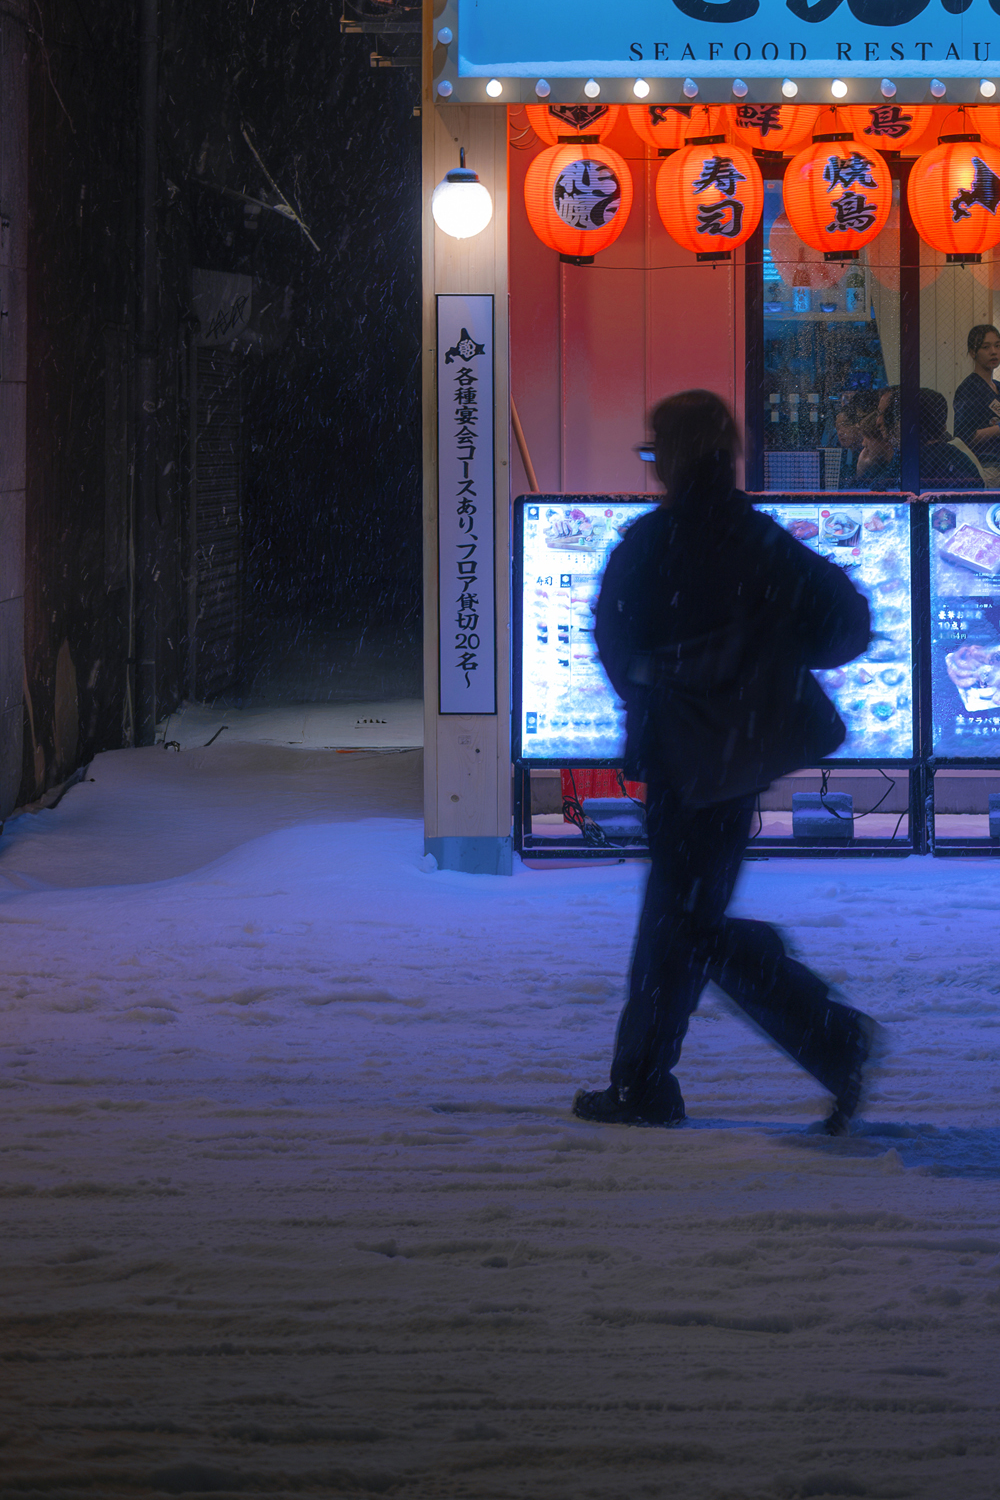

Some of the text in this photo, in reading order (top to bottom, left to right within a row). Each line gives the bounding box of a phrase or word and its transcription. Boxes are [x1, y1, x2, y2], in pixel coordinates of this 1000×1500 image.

[629, 42, 807, 61] SEAFOOD
[693, 156, 748, 238] 寿司
[822, 152, 880, 234] 焼鳥
